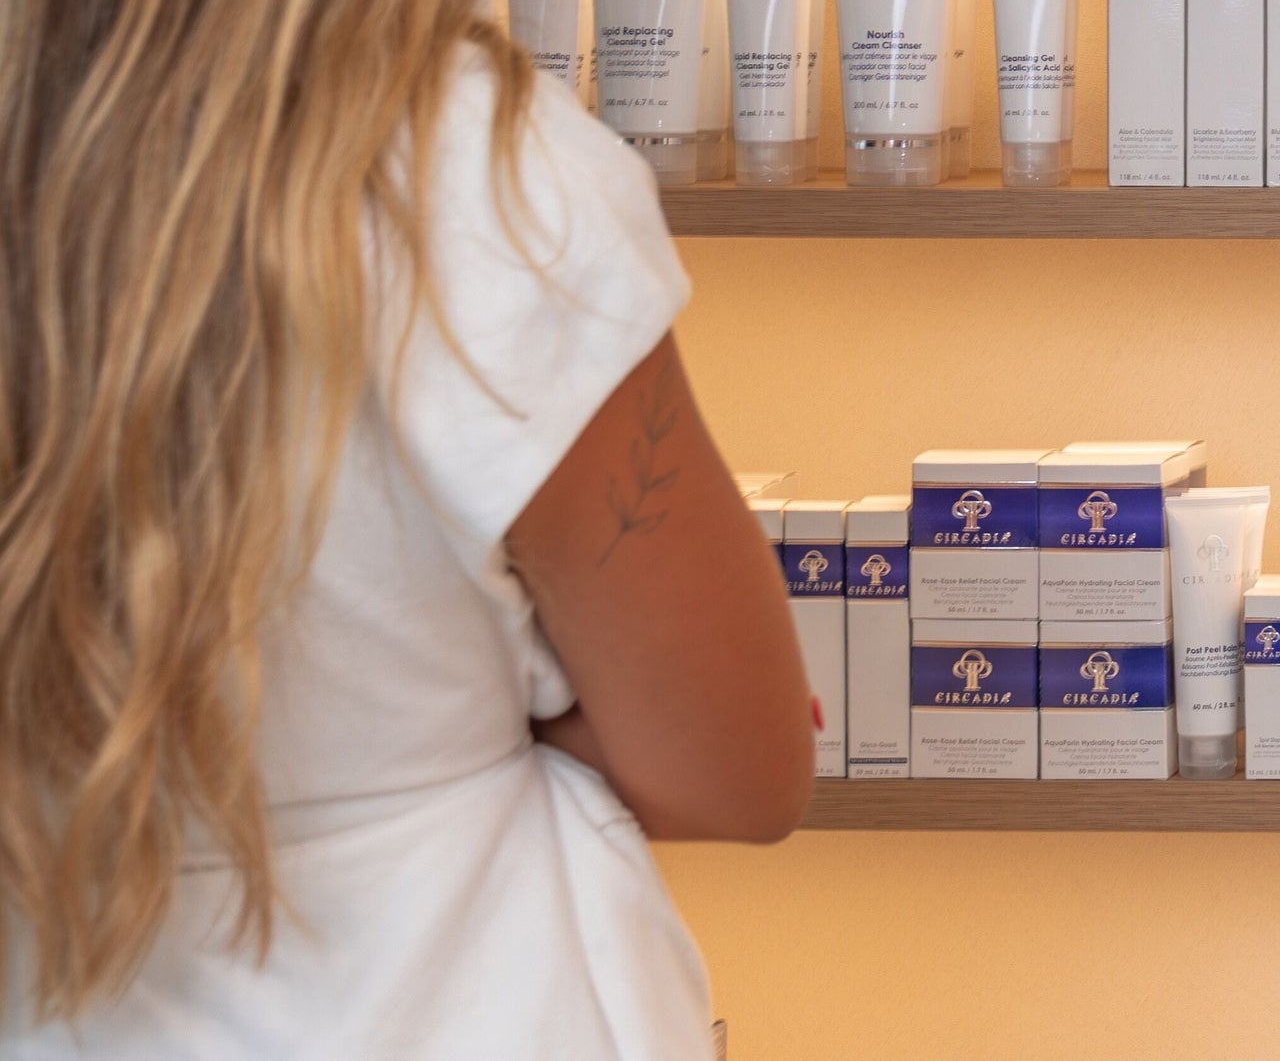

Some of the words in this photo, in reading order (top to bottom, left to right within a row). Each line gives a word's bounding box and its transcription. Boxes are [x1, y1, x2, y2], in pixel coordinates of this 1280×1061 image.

[602, 27, 621, 38] Lipid
[622, 26, 674, 38] Replacing
[867, 29, 905, 40] Nourish
[606, 38, 647, 48] Cleansing
[649, 38, 666, 47] Gel
[852, 42, 880, 50] Cream
[881, 41, 922, 50] Cleanser
[751, 52, 792, 61] Replacing
[1001, 55, 1039, 63] Cleansing
[736, 62, 774, 71] Cleansing
[776, 61, 791, 70] Gel
[1008, 64, 1041, 73] Salicylic
[1043, 64, 1061, 72] Acid
[1079, 579, 1113, 588] Hydrating
[1113, 579, 1136, 587] Facial
[1136, 579, 1161, 587] Cream
[1186, 646, 1203, 655] Post
[1204, 644, 1222, 654] Peel
